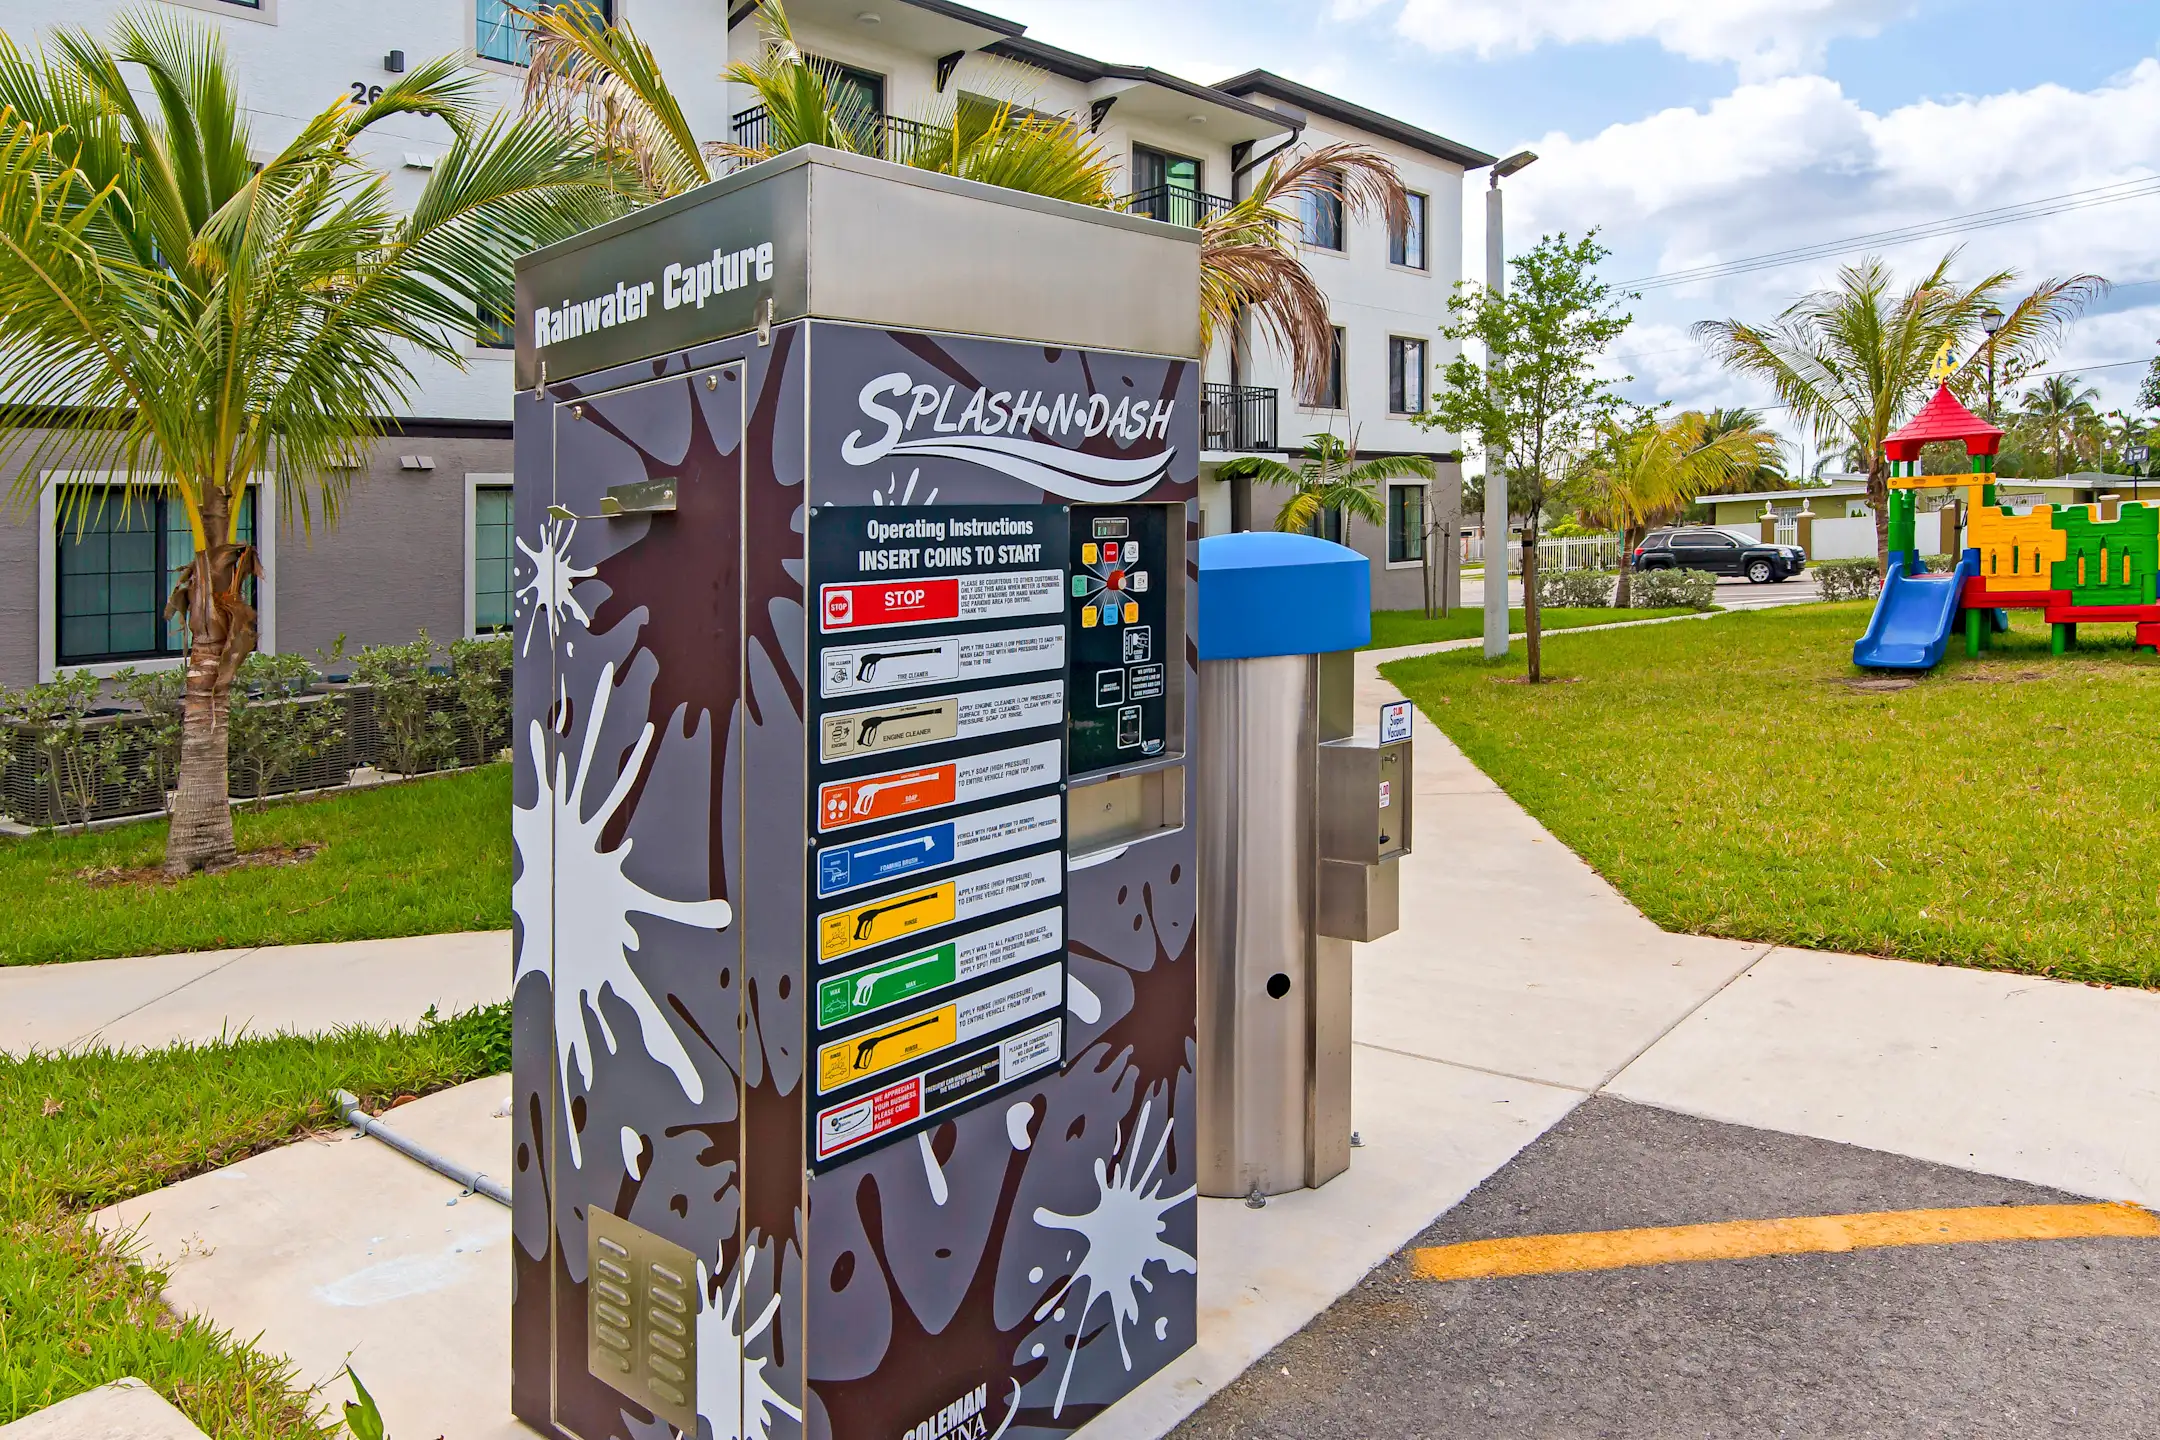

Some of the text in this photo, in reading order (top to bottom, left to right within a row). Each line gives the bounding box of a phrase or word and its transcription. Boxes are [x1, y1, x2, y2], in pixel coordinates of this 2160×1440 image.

[535, 242, 773, 348] Rainwater Capture
[867, 518, 1034, 544] Operating Instructions
[859, 544, 1042, 572] INSERT COINS TO START
[884, 590, 925, 606] STOP
[830, 602, 848, 612] STOP
[994, 698, 1015, 706] CLEANER
[959, 717, 984, 725] PRESSURE
[1390, 714, 1404, 727] Super
[883, 728, 931, 741] ENGINE CLEANER
[1388, 728, 1406, 738] Vacuum
[960, 770, 974, 778] APPLY
[976, 767, 989, 775] SOAP
[985, 772, 1003, 781] VEHICLE
[1006, 769, 1019, 777] FROM
[880, 858, 918, 872] FOAMING BRUSH
[959, 887, 974, 896] APPLY
[976, 883, 989, 892] RINSE
[966, 893, 983, 903] ENTIRE
[985, 888, 1004, 898] VEHICLE
[1006, 884, 1020, 893] FROM
[960, 948, 975, 958] APPLY
[977, 944, 986, 952] WAX
[961, 965, 975, 974] APPLY
[977, 961, 988, 969] SPOT
[960, 1007, 975, 1018] APPLY
[977, 1002, 991, 1012] RINSE
[968, 1013, 984, 1024] ENTIRE
[986, 1006, 1005, 1018] VEHICLE
[1007, 1000, 1020, 1010] FROM
[905, 1044, 918, 1052] RINSE
[874, 1082, 916, 1103] WE APPRECIATE
[874, 1090, 916, 1112] YOUR BUSINESS
[874, 1108, 894, 1121] PLEASE
[895, 1102, 910, 1114] COME
